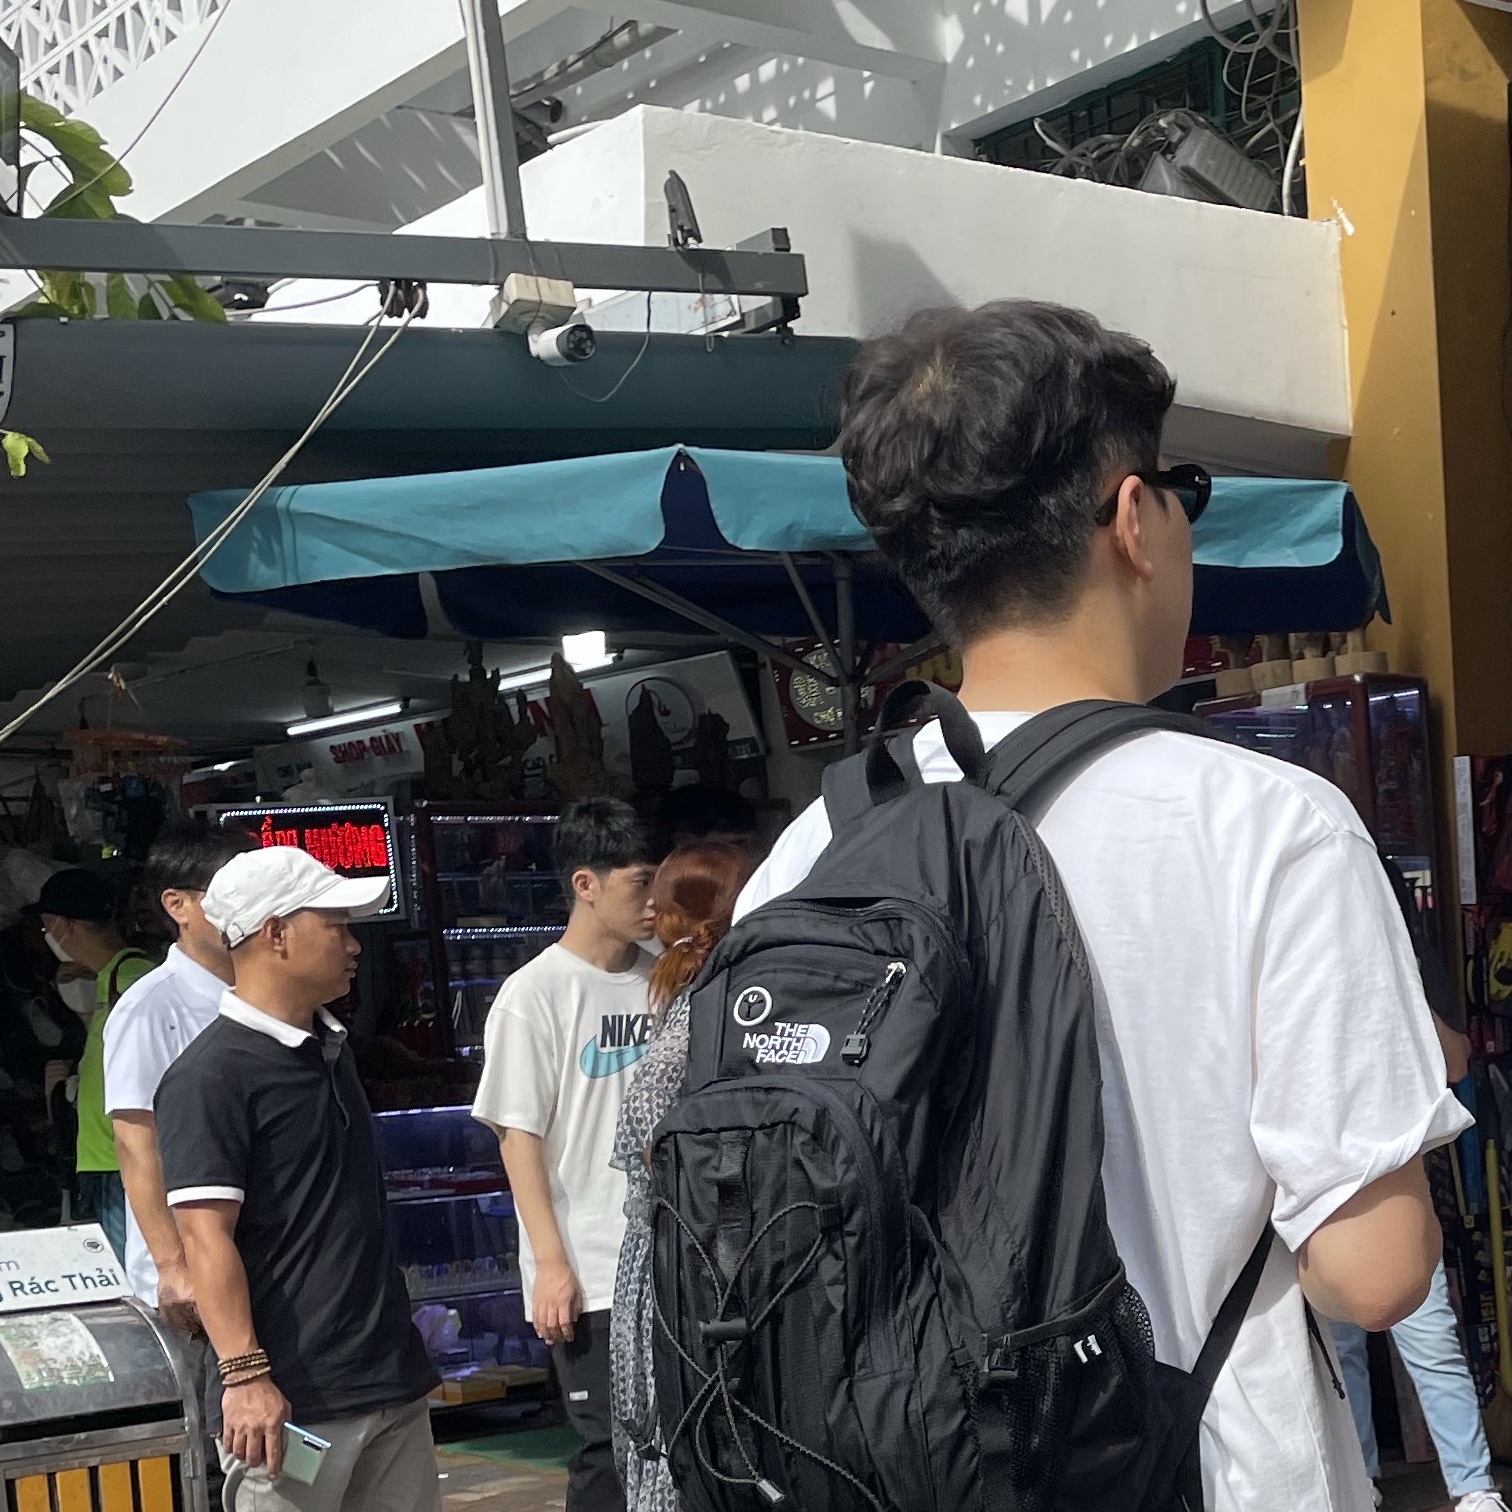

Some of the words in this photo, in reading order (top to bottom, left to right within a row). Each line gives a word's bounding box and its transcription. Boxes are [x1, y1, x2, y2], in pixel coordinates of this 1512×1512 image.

[328, 739, 368, 764] SHOP
[600, 1013, 656, 1048] NIKE
[774, 1021, 810, 1038] THE
[742, 1032, 805, 1051] NORTH
[755, 1048, 801, 1065] FACE
[9, 1276, 59, 1297] Rác
[61, 1267, 120, 1290] Thải
